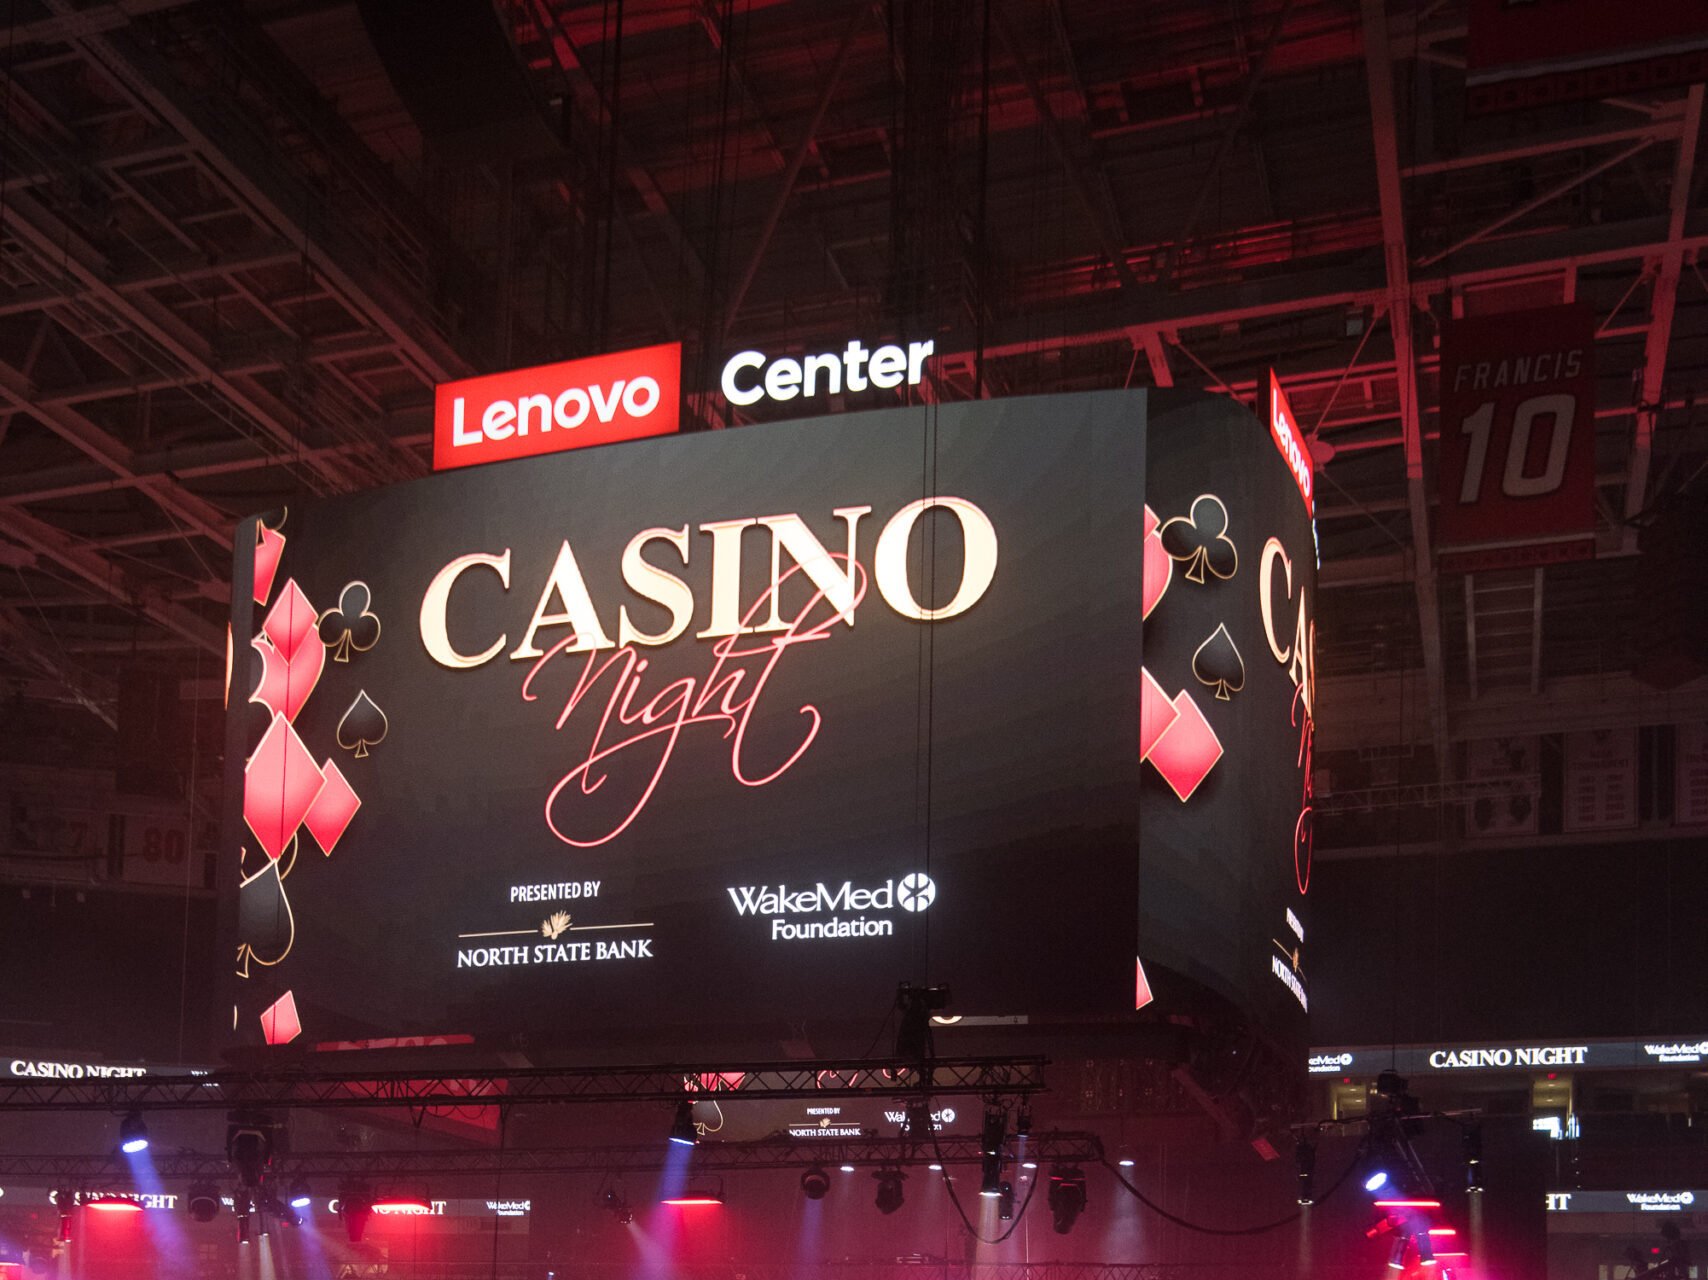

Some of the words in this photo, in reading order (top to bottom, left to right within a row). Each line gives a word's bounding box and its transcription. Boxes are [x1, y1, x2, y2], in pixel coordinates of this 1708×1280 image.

[1454, 350, 1583, 392] FRANCIS
[453, 375, 660, 447] Lenovo
[721, 339, 935, 406] Center
[1273, 388, 1311, 498] Lenovo
[1459, 394, 1576, 503] 10
[419, 496, 999, 669] CASINO
[522, 552, 867, 848] Night
[510, 882, 582, 903] PRESENTED
[583, 881, 601, 899] BY
[727, 879, 893, 917] WakeMed
[772, 918, 893, 940] Foundation
[457, 947, 529, 968] NORTH
[534, 943, 593, 964] STATE
[596, 938, 653, 961] BANK
[1429, 1050, 1512, 1069] CASINO
[1514, 1046, 1588, 1066] NIGHT
[1644, 1043, 1699, 1055] WakeMed
[10, 1059, 84, 1079] CASINO
[789, 1129, 817, 1137] NORTH
[817, 1128, 839, 1136] STATE
[840, 1128, 861, 1136] BANK
